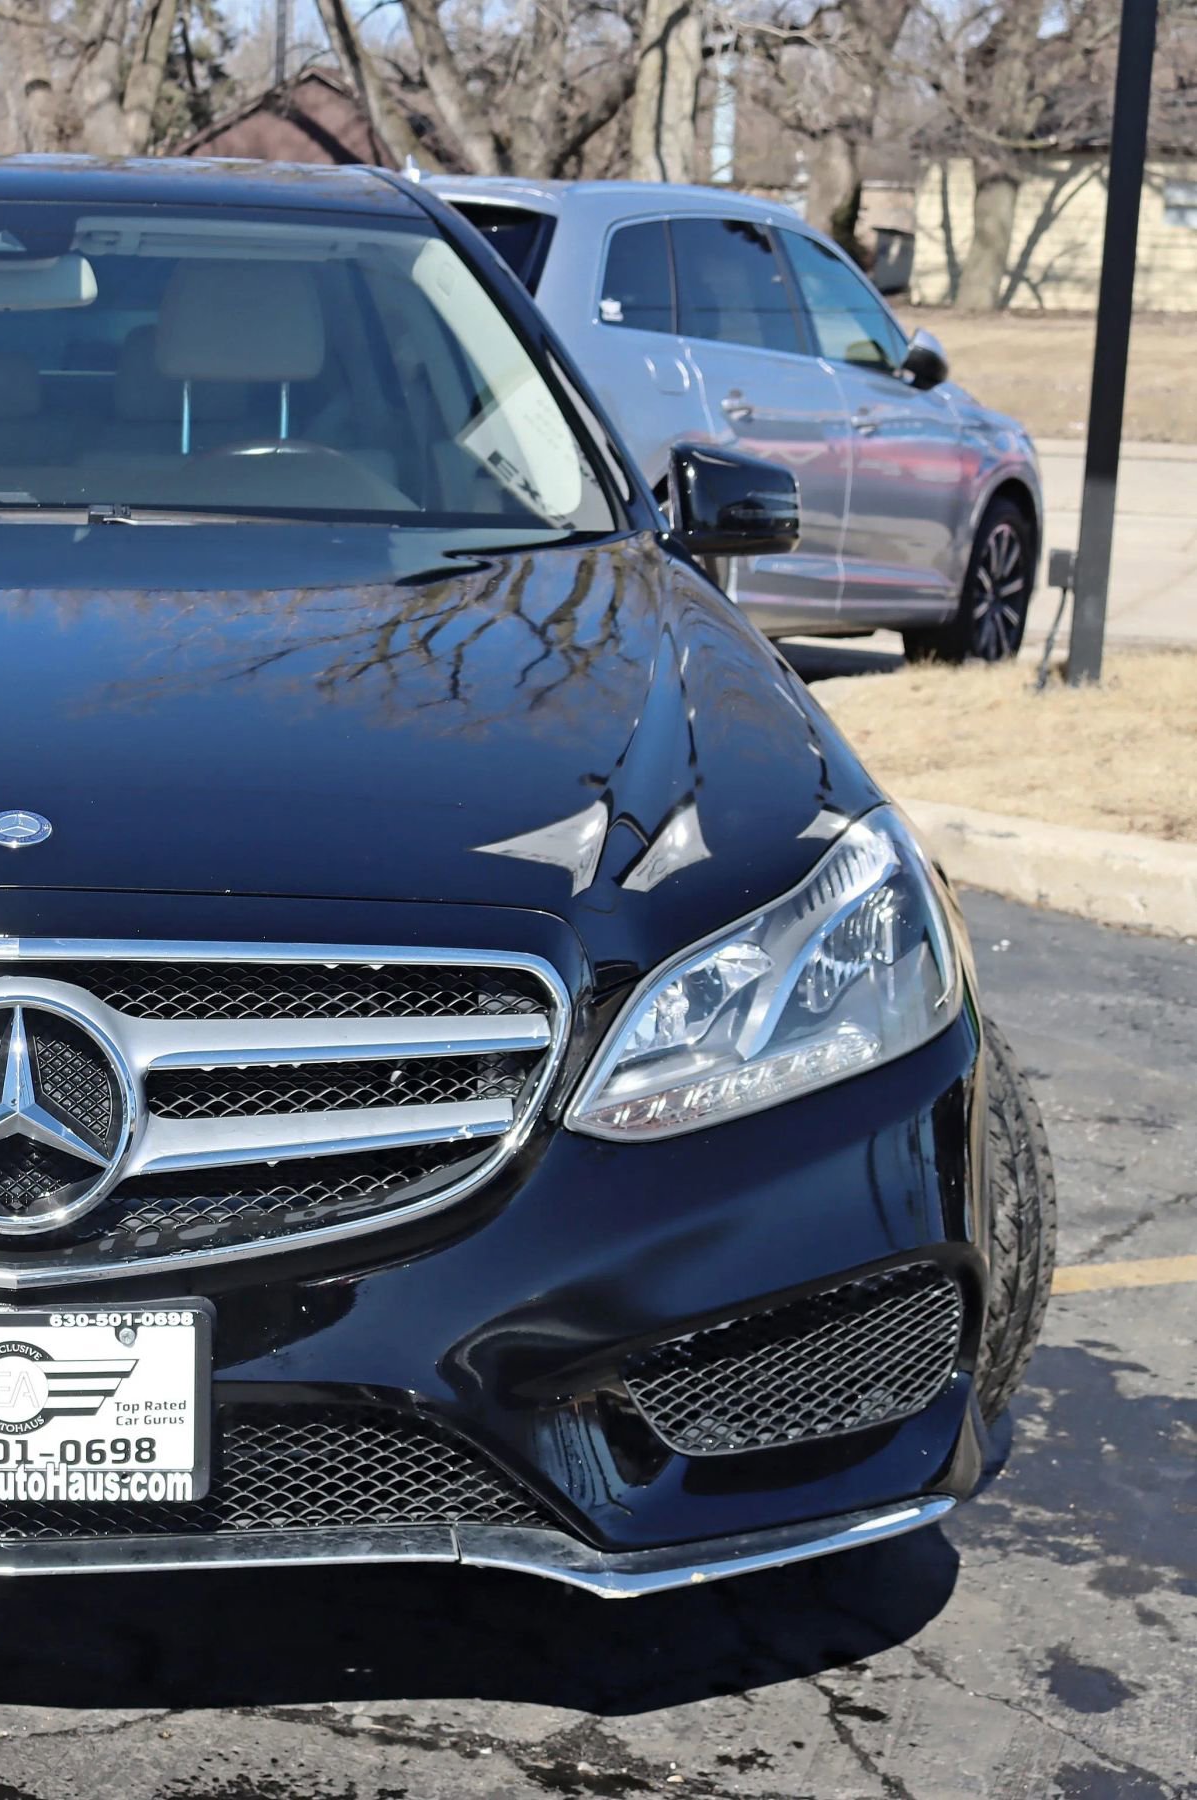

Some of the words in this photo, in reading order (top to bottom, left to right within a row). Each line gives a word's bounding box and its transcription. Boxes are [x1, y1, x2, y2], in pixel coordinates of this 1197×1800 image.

[49, 1312, 194, 1328] 630-501-0698
[114, 1401, 140, 1414] Top
[144, 1400, 187, 1411] Rated
[115, 1415, 140, 1426] Car
[143, 1415, 185, 1425] Gurus
